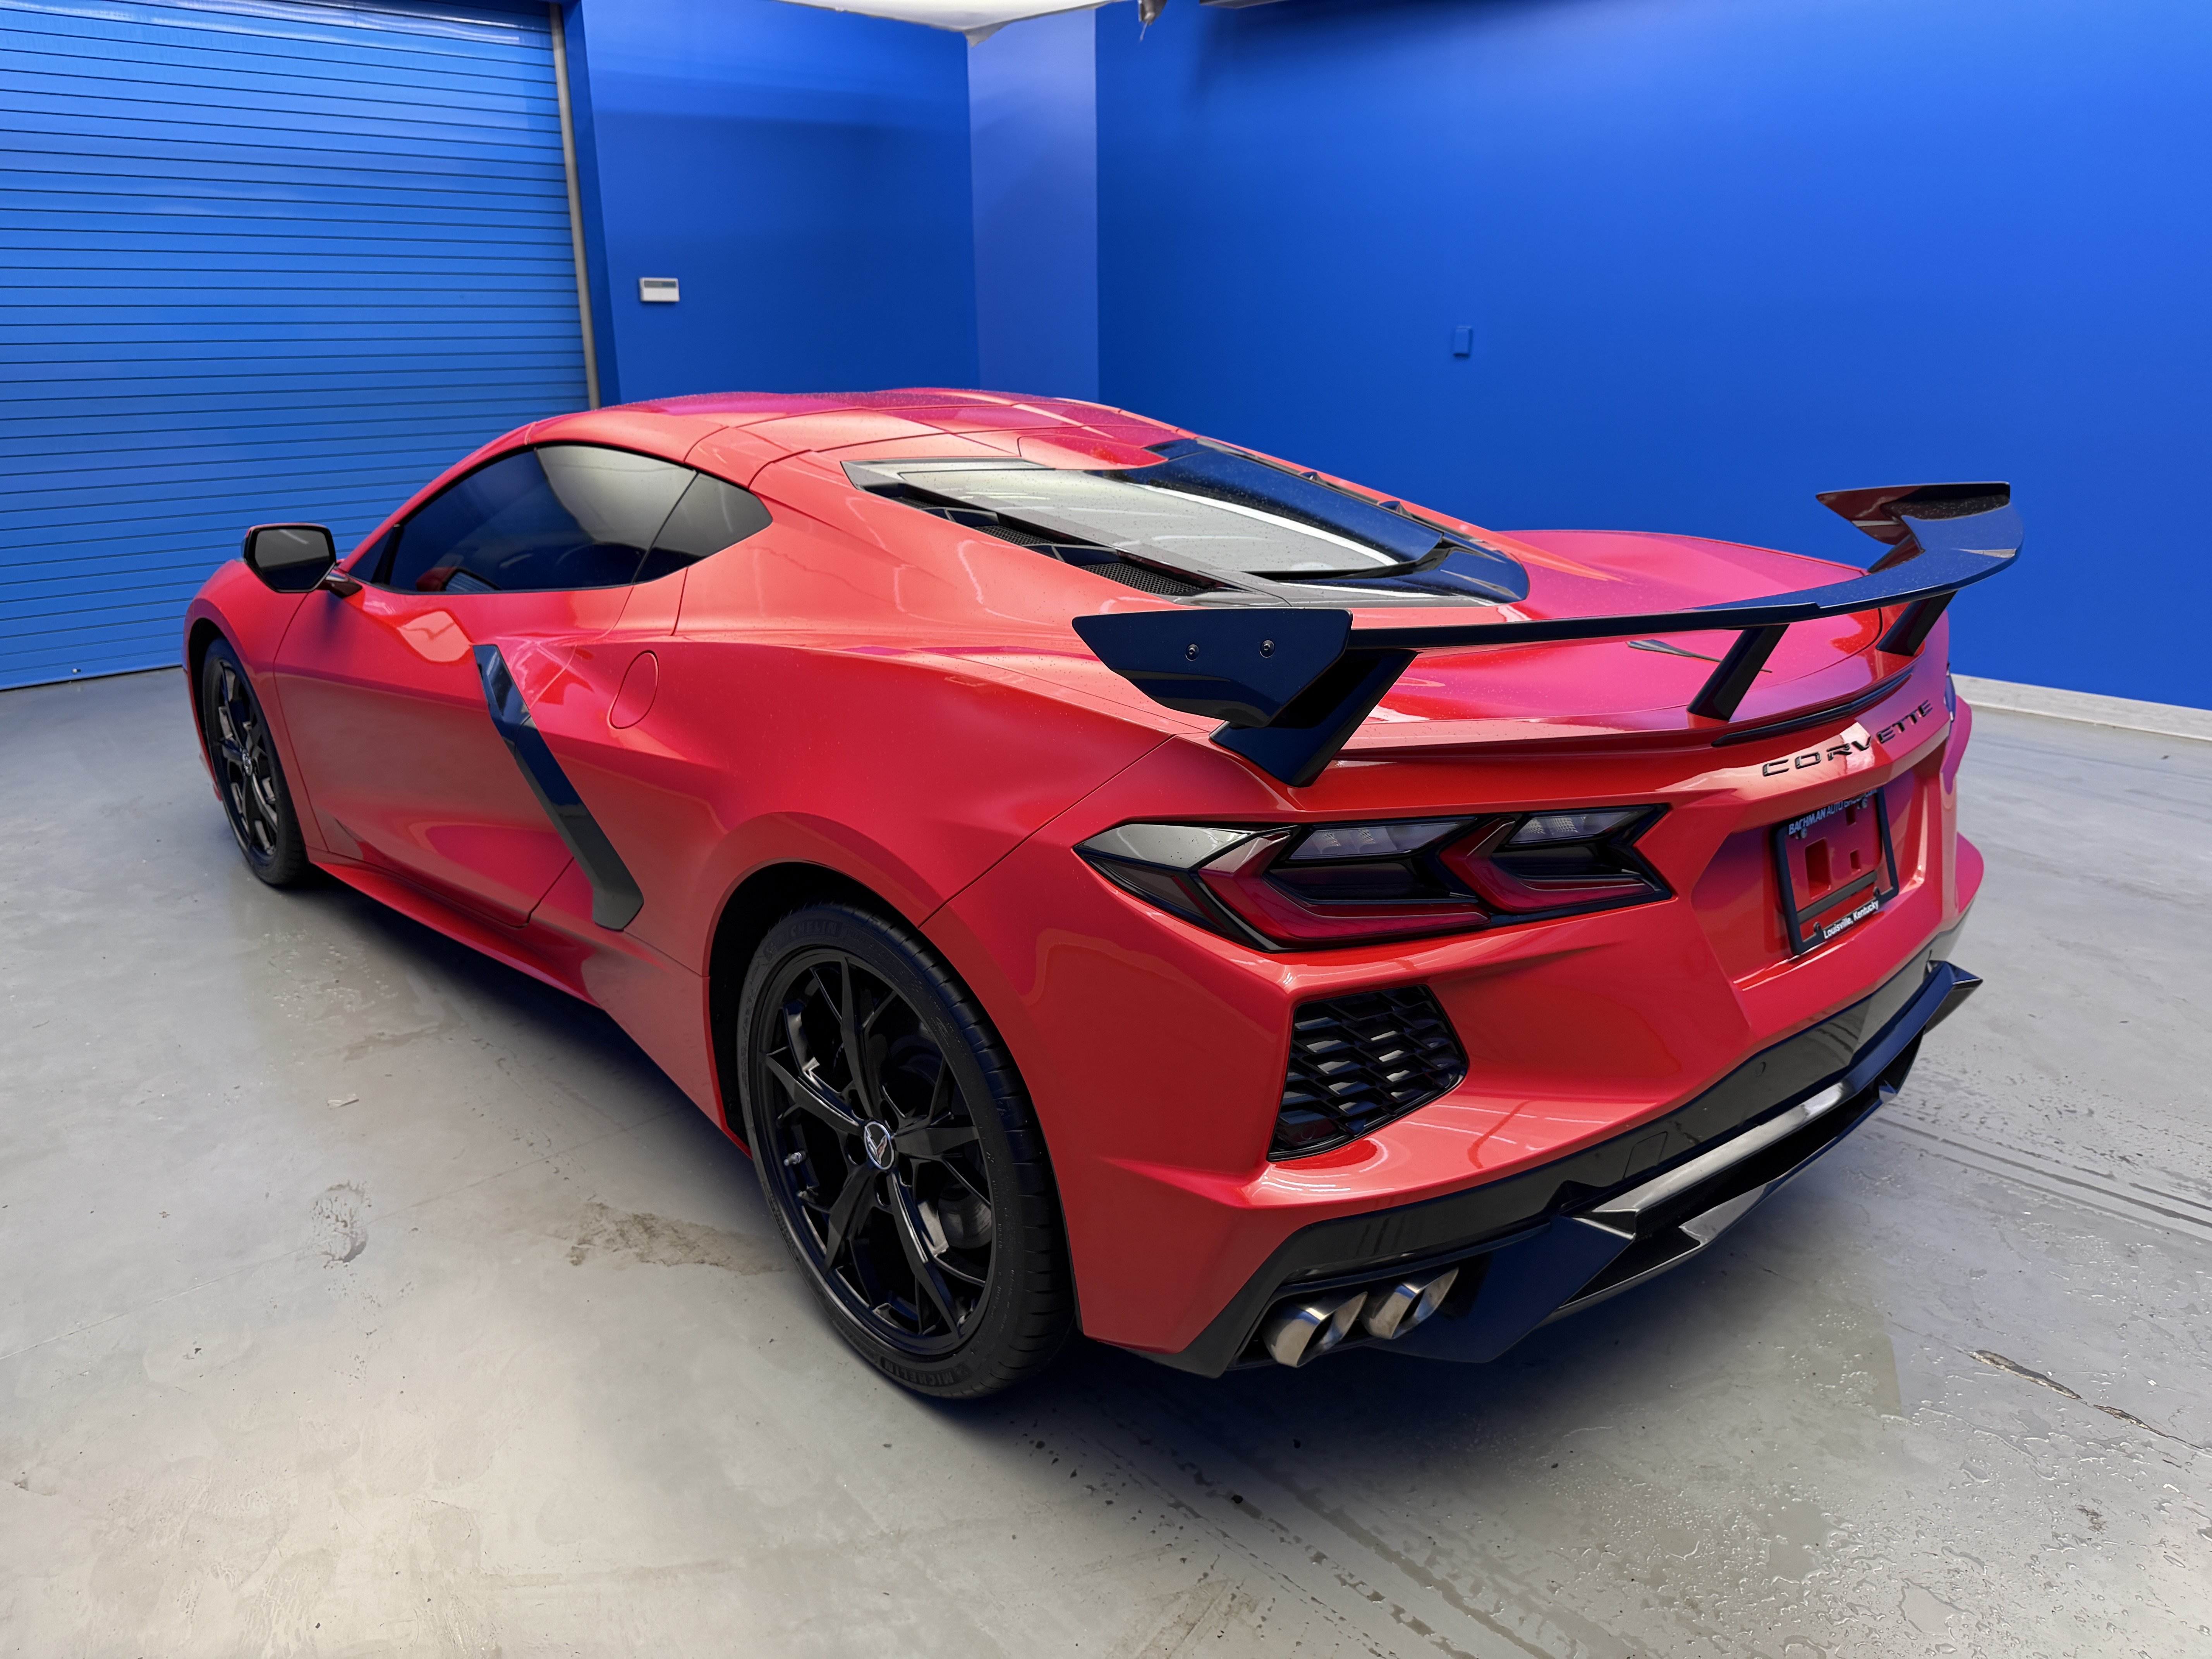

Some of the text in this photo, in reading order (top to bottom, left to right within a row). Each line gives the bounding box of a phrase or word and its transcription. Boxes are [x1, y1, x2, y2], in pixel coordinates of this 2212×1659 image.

[1762, 699, 1933, 777] CORVETTE
[1789, 808, 1826, 835] BACHMAN
[1823, 900, 1879, 939] Louisville, Kentucky
[884, 1360, 954, 1386] MICHELIN
